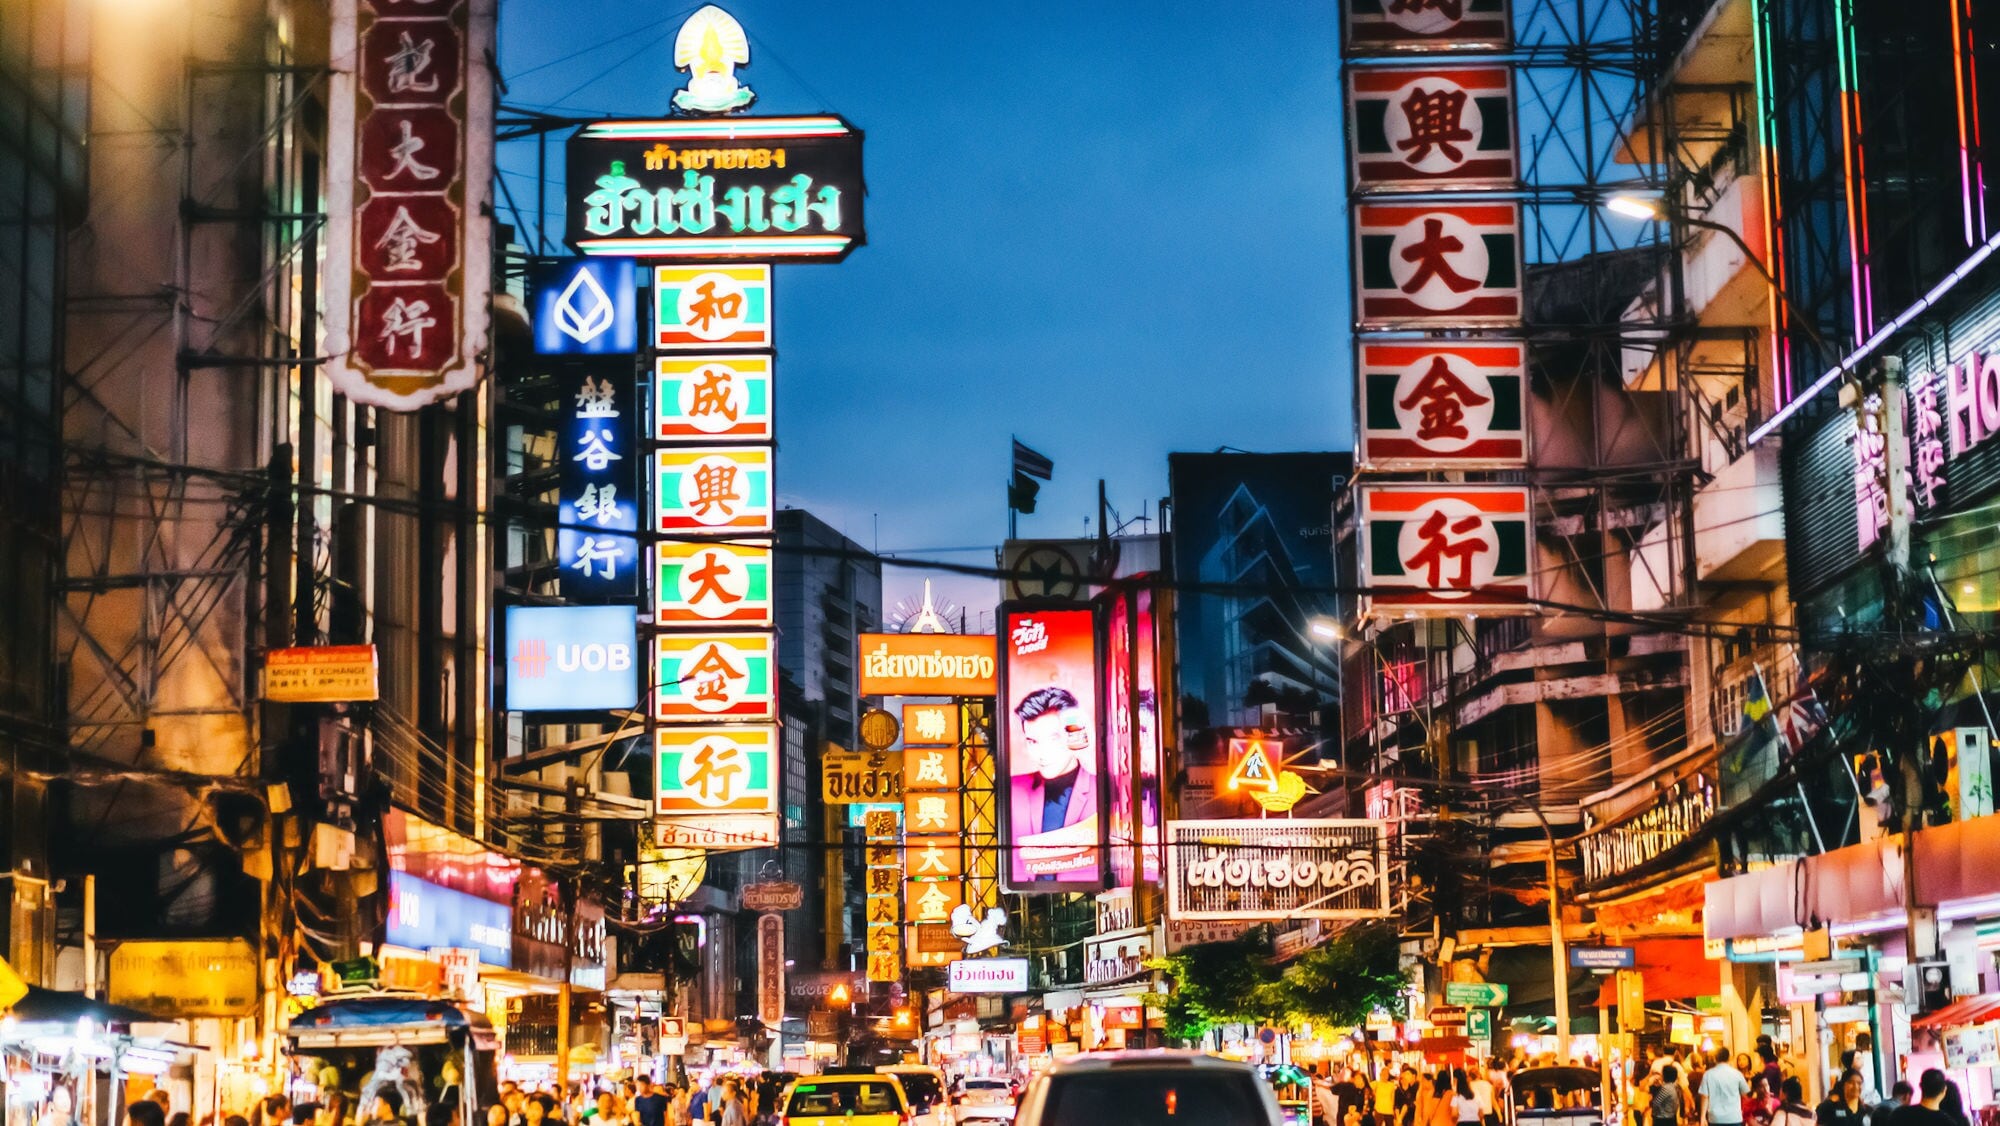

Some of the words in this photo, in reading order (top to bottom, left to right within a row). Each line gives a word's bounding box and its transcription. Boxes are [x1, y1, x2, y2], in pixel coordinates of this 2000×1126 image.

[376, 0, 441, 361] 記大金行
[1390, 0, 1490, 588] 興大金行
[573, 375, 624, 580] 盤谷銀行
[685, 280, 745, 802] 和成興大金行
[272, 668, 308, 676] MONEY
[313, 667, 366, 676] EXCHANGE
[556, 643, 632, 672] UOB
